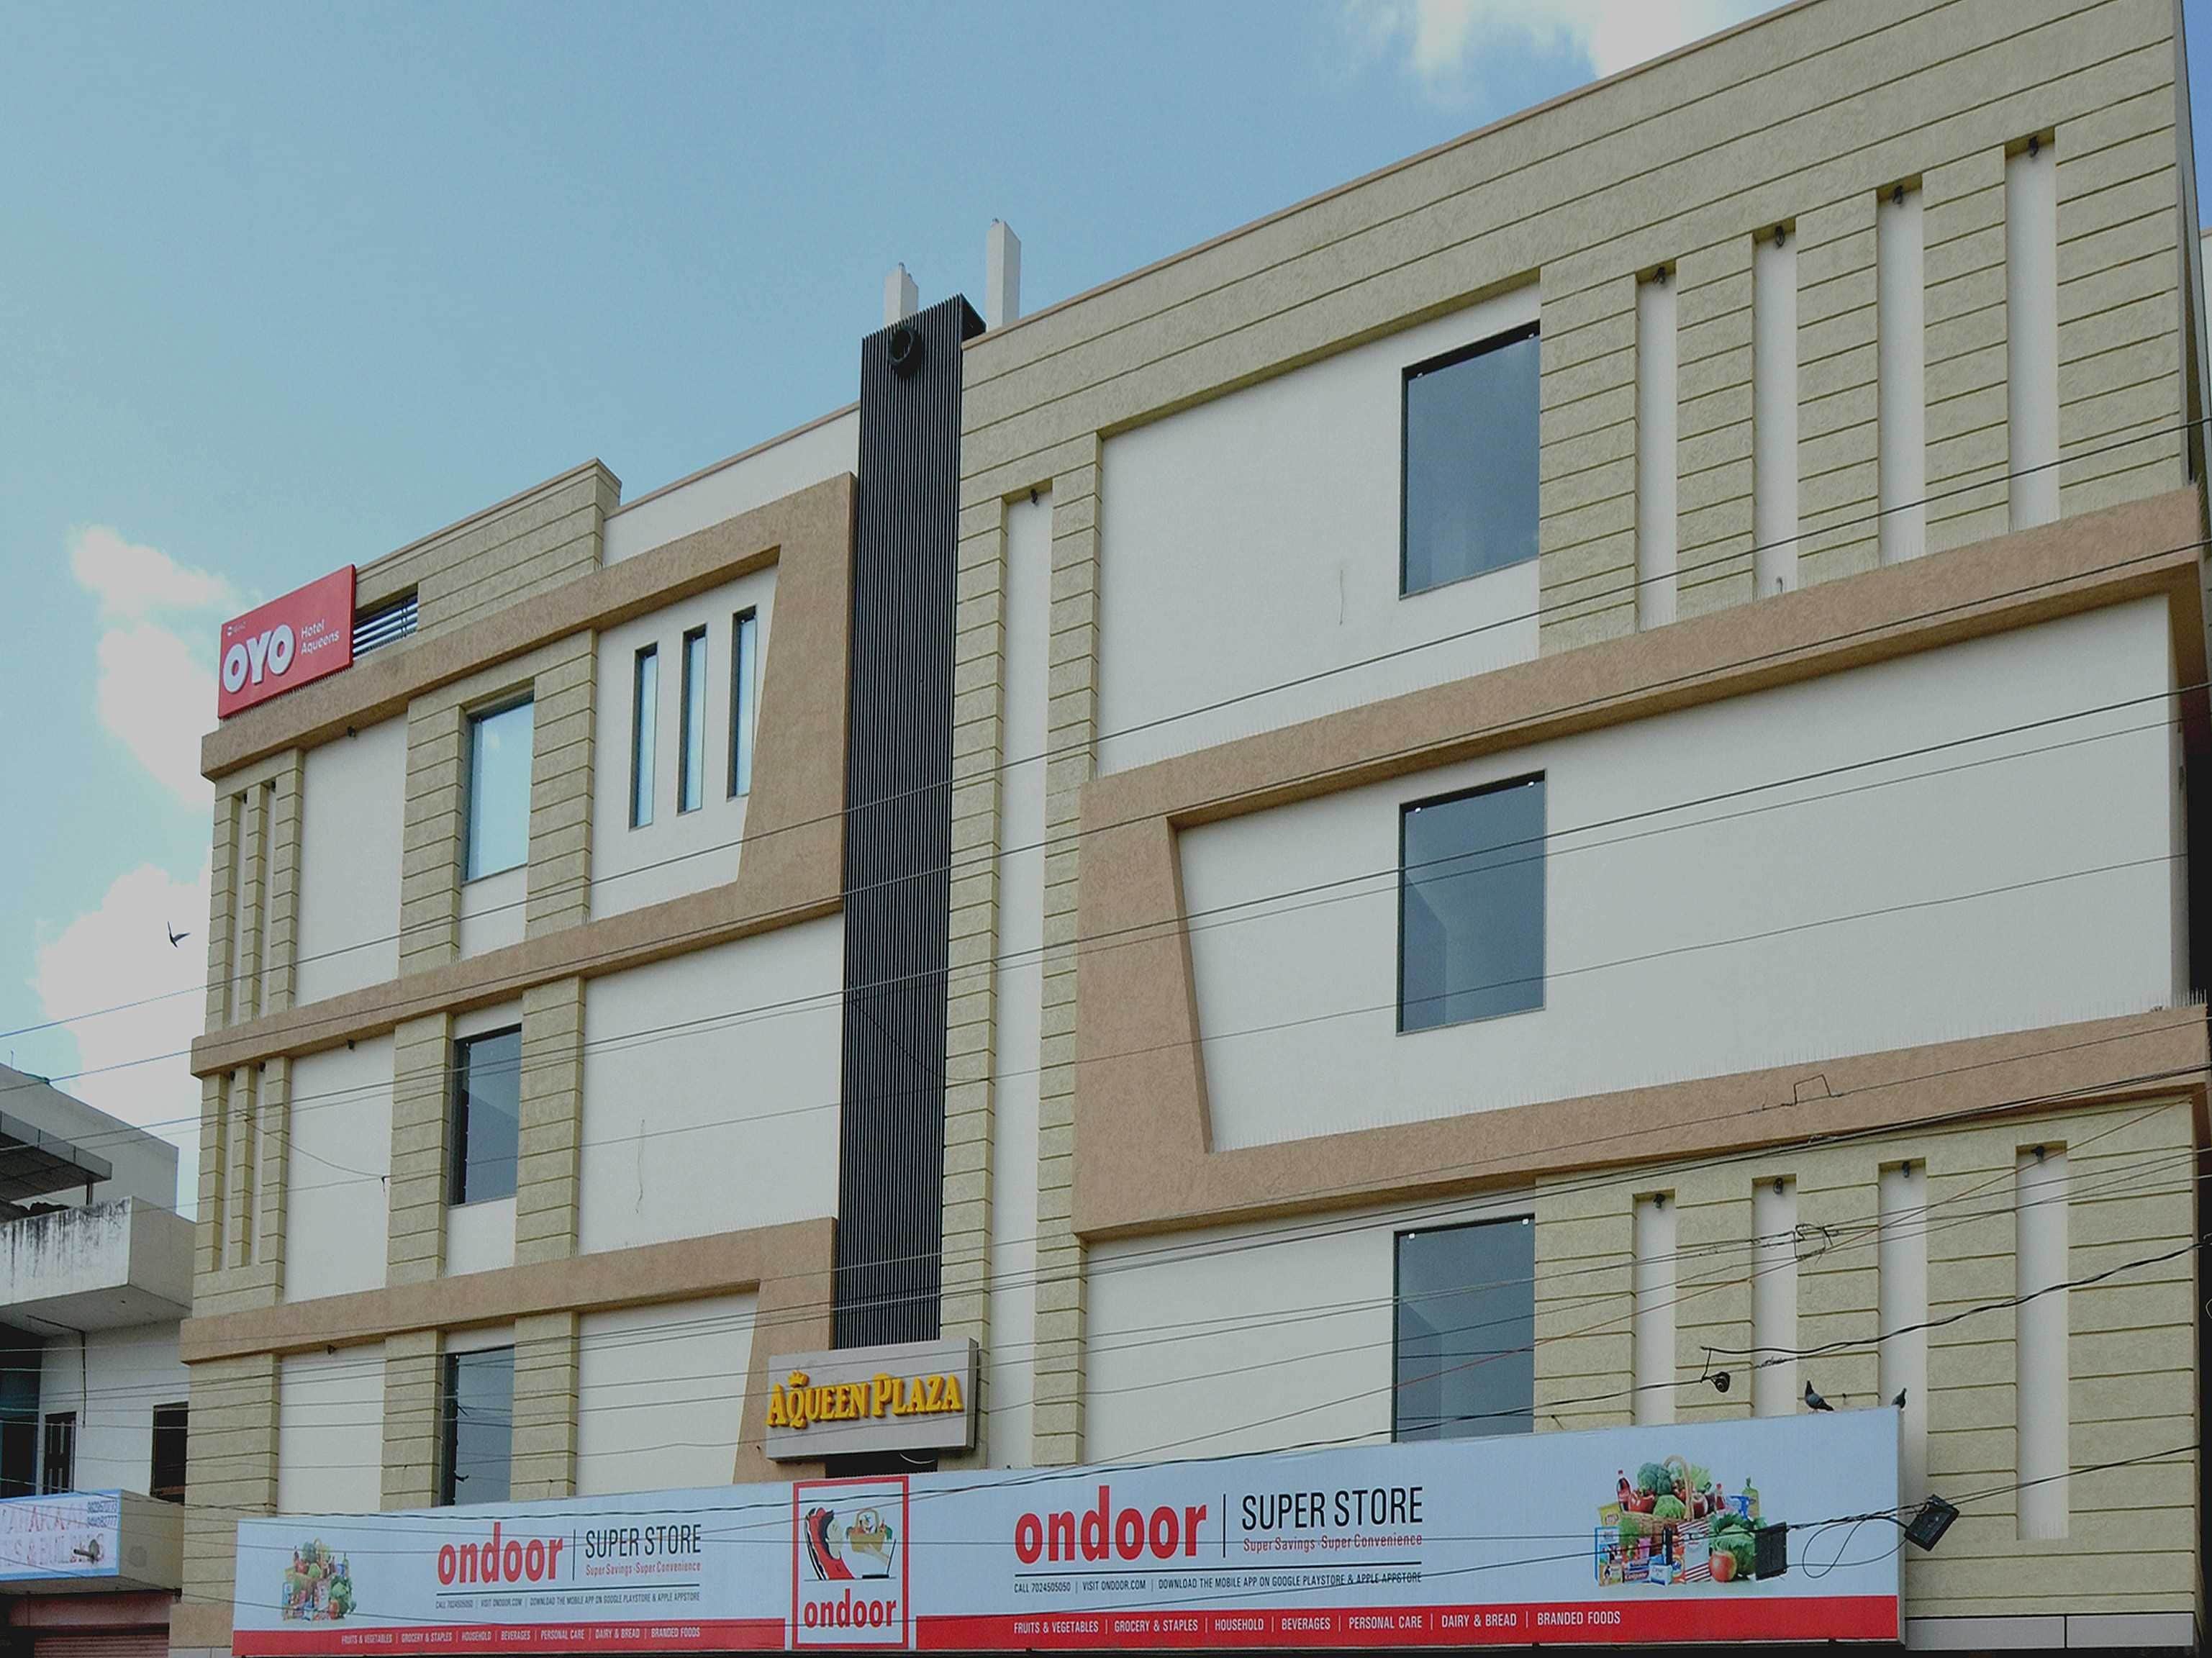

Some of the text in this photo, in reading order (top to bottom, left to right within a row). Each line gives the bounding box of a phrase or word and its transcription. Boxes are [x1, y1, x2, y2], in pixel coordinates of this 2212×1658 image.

[301, 619, 325, 638] Hotel
[301, 630, 340, 655] Aqueens
[223, 625, 295, 693] OYO
[766, 1372, 965, 1429] AQUEEN PLAZA
[1242, 1487, 1423, 1531] SUPER STORE
[1014, 1485, 1207, 1564] ondoor
[438, 1521, 563, 1586] ondoor
[585, 1523, 702, 1559] SUPER STORE
[1243, 1532, 1423, 1554] Super Savings Super Convenience
[586, 1564, 605, 1578] Super
[606, 1562, 633, 1577] Savings
[657, 1560, 702, 1575] Convenience
[1013, 1582, 1029, 1593] CALL
[1082, 1580, 1099, 1590] VISIT
[1101, 1579, 1146, 1591] ONDOOR.COM
[1158, 1577, 1197, 1589] DOWNLOAD
[1200, 1577, 1213, 1588] THE
[1215, 1577, 1241, 1588] MOBILE
[1243, 1576, 1258, 1587] APP
[1260, 1575, 1270, 1587] ON
[1272, 1575, 1300, 1587] GOOGLE
[1302, 1573, 1345, 1585] PLAYSTORE
[1347, 1573, 1354, 1584] &
[1356, 1572, 1379, 1584] APPLE
[1382, 1571, 1422, 1583] APPSTORE
[804, 1588, 897, 1628] ondoor
[1013, 1611, 1621, 1634] FRUITS & VEGETABLES GROCERY & STAPLES HOUSEHOLD BEVERAGES PERSONAL CARE DAIRY & BREAD BRANDED FOODS
[430, 1631, 453, 1642] STAPLES
[501, 1629, 531, 1641] BEVERAGES
[541, 1629, 568, 1640] PERSONAL
[570, 1628, 585, 1639] CARE
[595, 1628, 612, 1639] DAIRY
[621, 1627, 640, 1639] BREAD
[651, 1626, 679, 1638] BRANDED
[680, 1626, 701, 1638] FOODS
